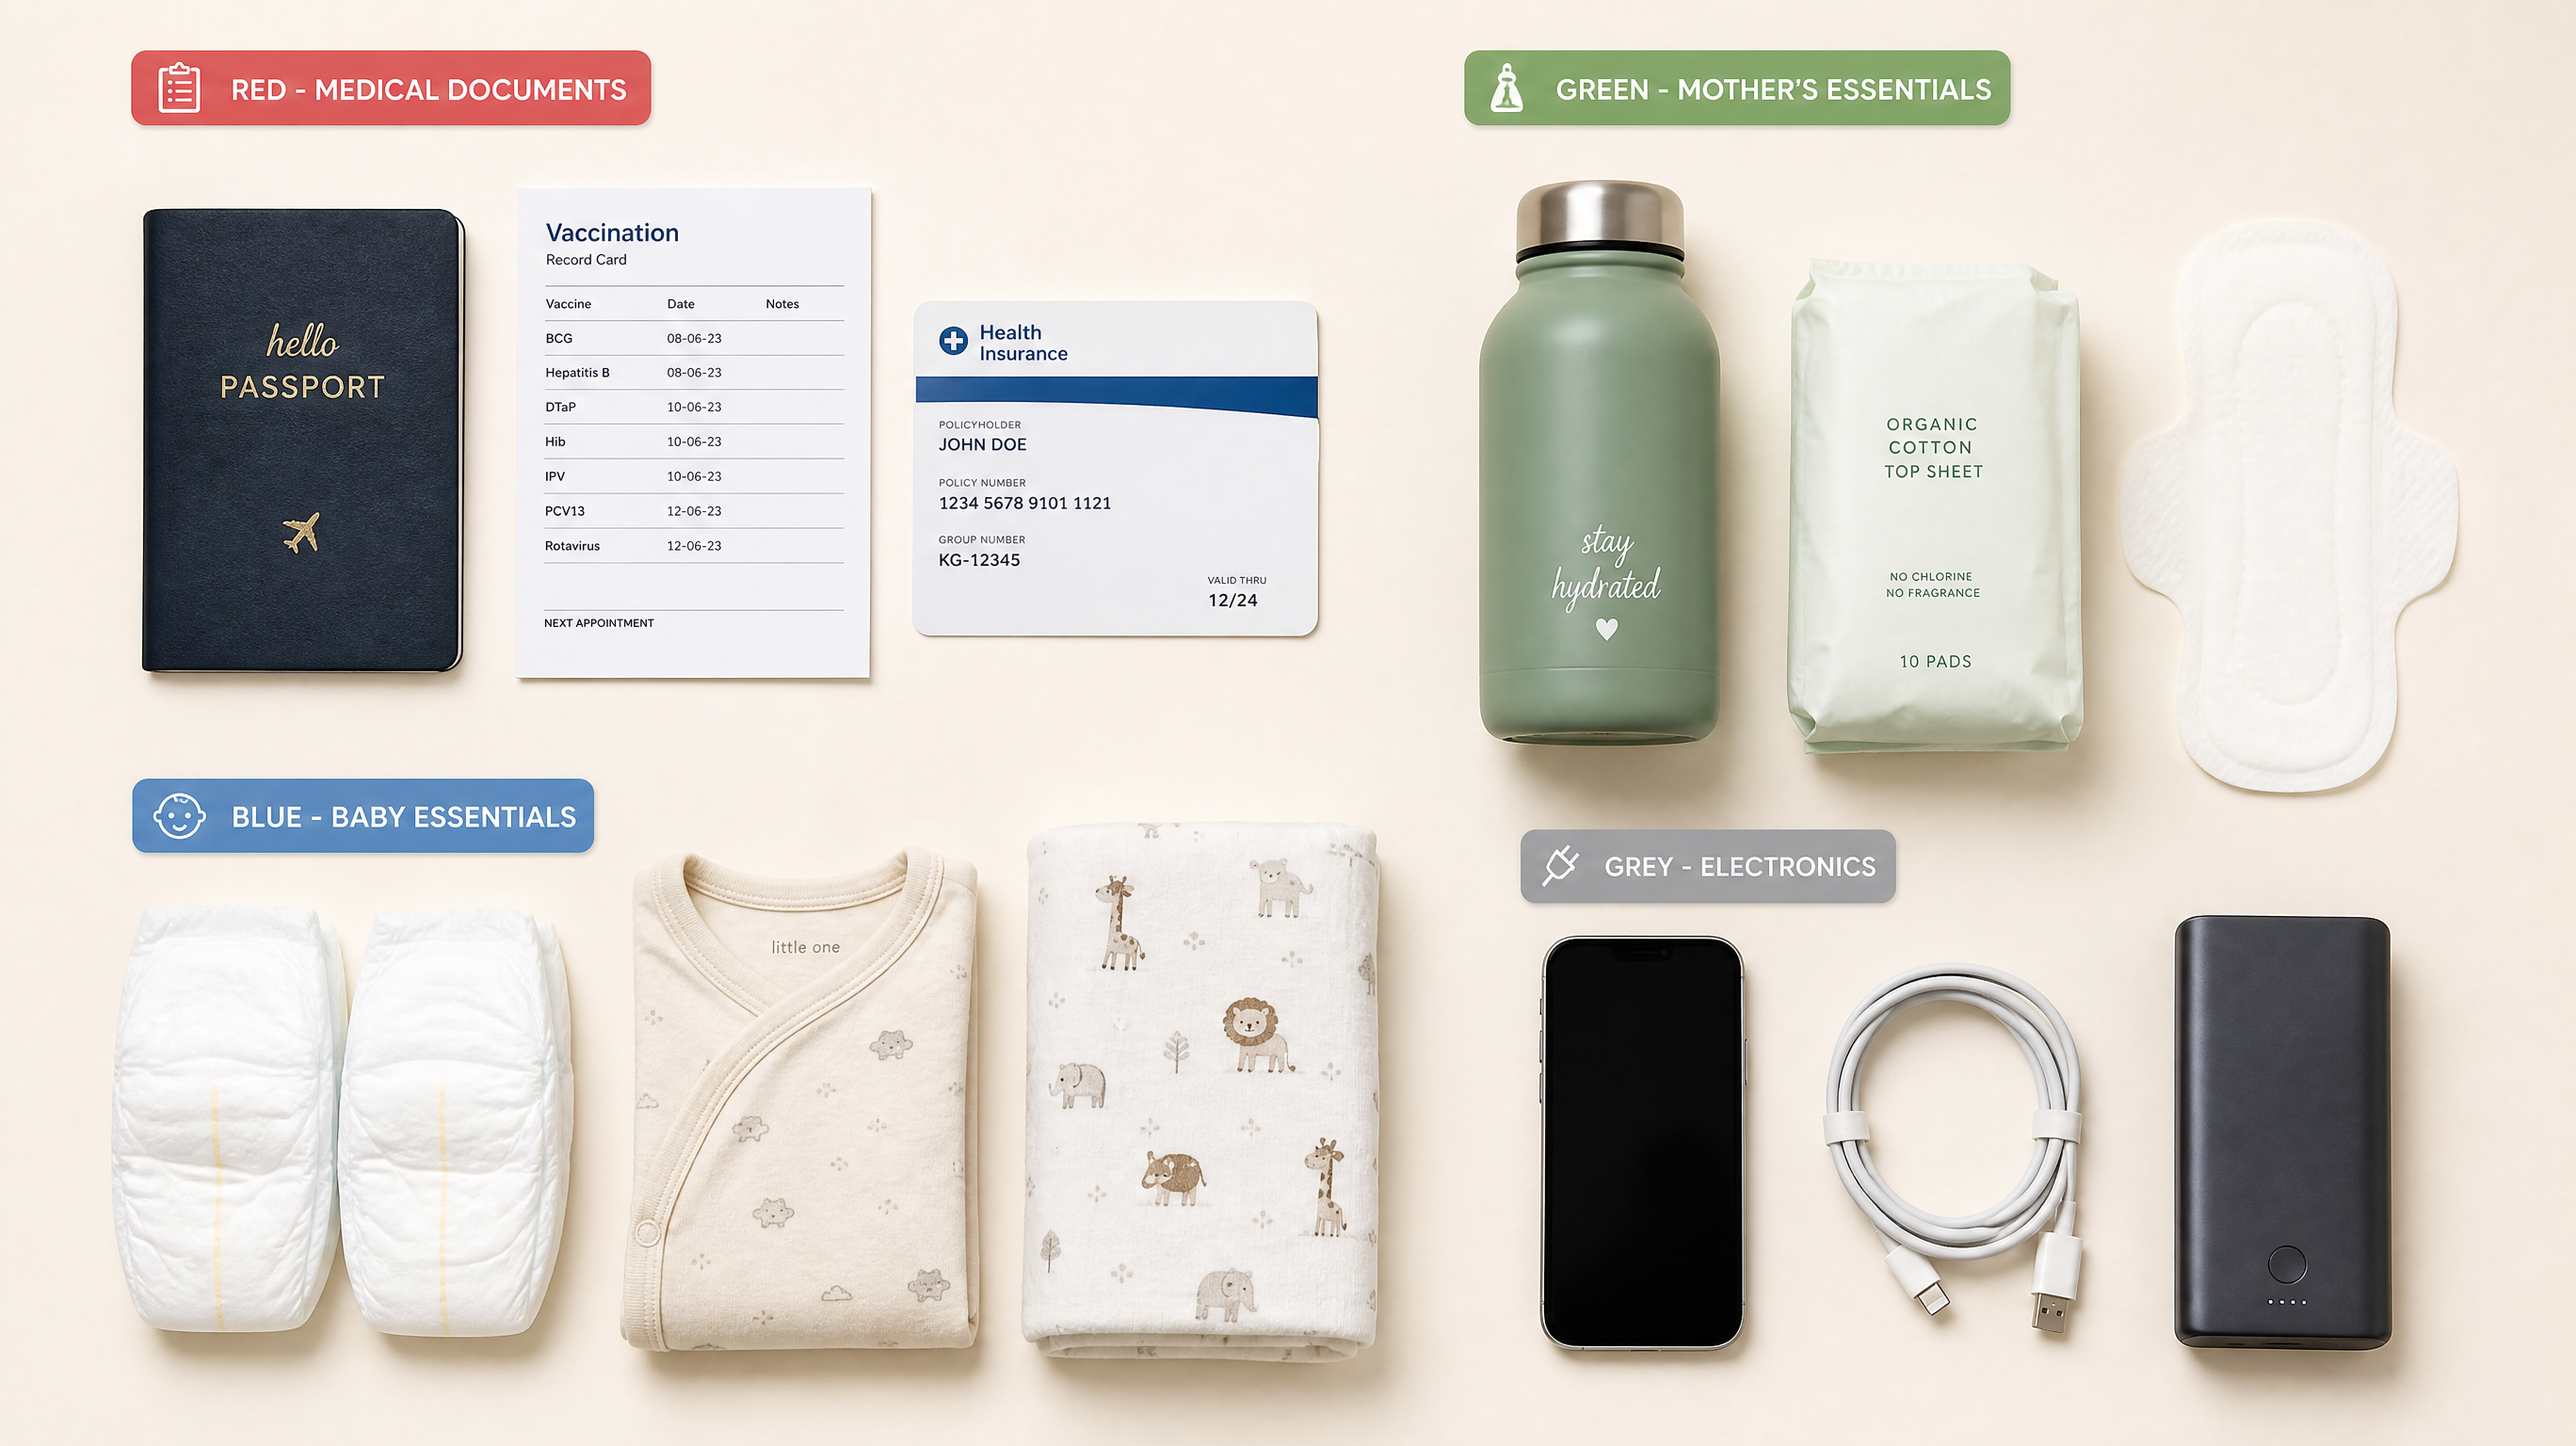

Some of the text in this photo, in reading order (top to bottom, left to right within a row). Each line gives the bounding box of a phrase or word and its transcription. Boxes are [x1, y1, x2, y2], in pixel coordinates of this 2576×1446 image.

[545, 222, 679, 243] Vaccination
[546, 253, 627, 265] Record Card
[545, 298, 800, 310] Vaccine Date Notes
[546, 332, 722, 345] BCG 08-06-23
[980, 323, 1042, 341] Health
[266, 322, 341, 357] hello
[980, 345, 1069, 362] Insurance
[545, 367, 722, 380] Hepatitis B 08-06-23
[221, 374, 385, 399] PASSPORT
[545, 401, 722, 412] DTaP 10-06-23
[939, 420, 1022, 430] POLICYHOLDER
[1887, 417, 1977, 431] ORGANIC
[545, 436, 722, 447] Hib 10-06-23
[938, 437, 1027, 452] JOHN DOE
[1889, 440, 1972, 455] COTTON
[545, 471, 722, 482] IPV 10-06-23
[1884, 464, 1984, 479] TOP SHEET
[939, 477, 1026, 488] POLICY NUMBER
[940, 496, 1111, 510] 1234 5678 9101 1121
[545, 506, 722, 517] PCV13 12-06-23
[545, 539, 722, 552] Rotavirus 12-06-23
[938, 535, 1026, 545] GROUP NUMBER
[1581, 523, 1635, 570] stay
[939, 553, 1021, 568] KG-12345
[1207, 575, 1267, 585] VALID THRU
[1890, 571, 1972, 582] NO CHLORINE
[1551, 565, 1663, 615] hydrated
[1886, 587, 1980, 598] NO FRAGRANCE
[1209, 592, 1258, 609] 12/24
[544, 618, 655, 628] NEXT APPOINTMENT
[1900, 654, 1972, 668] 10 PADS
[772, 940, 841, 955] little one
